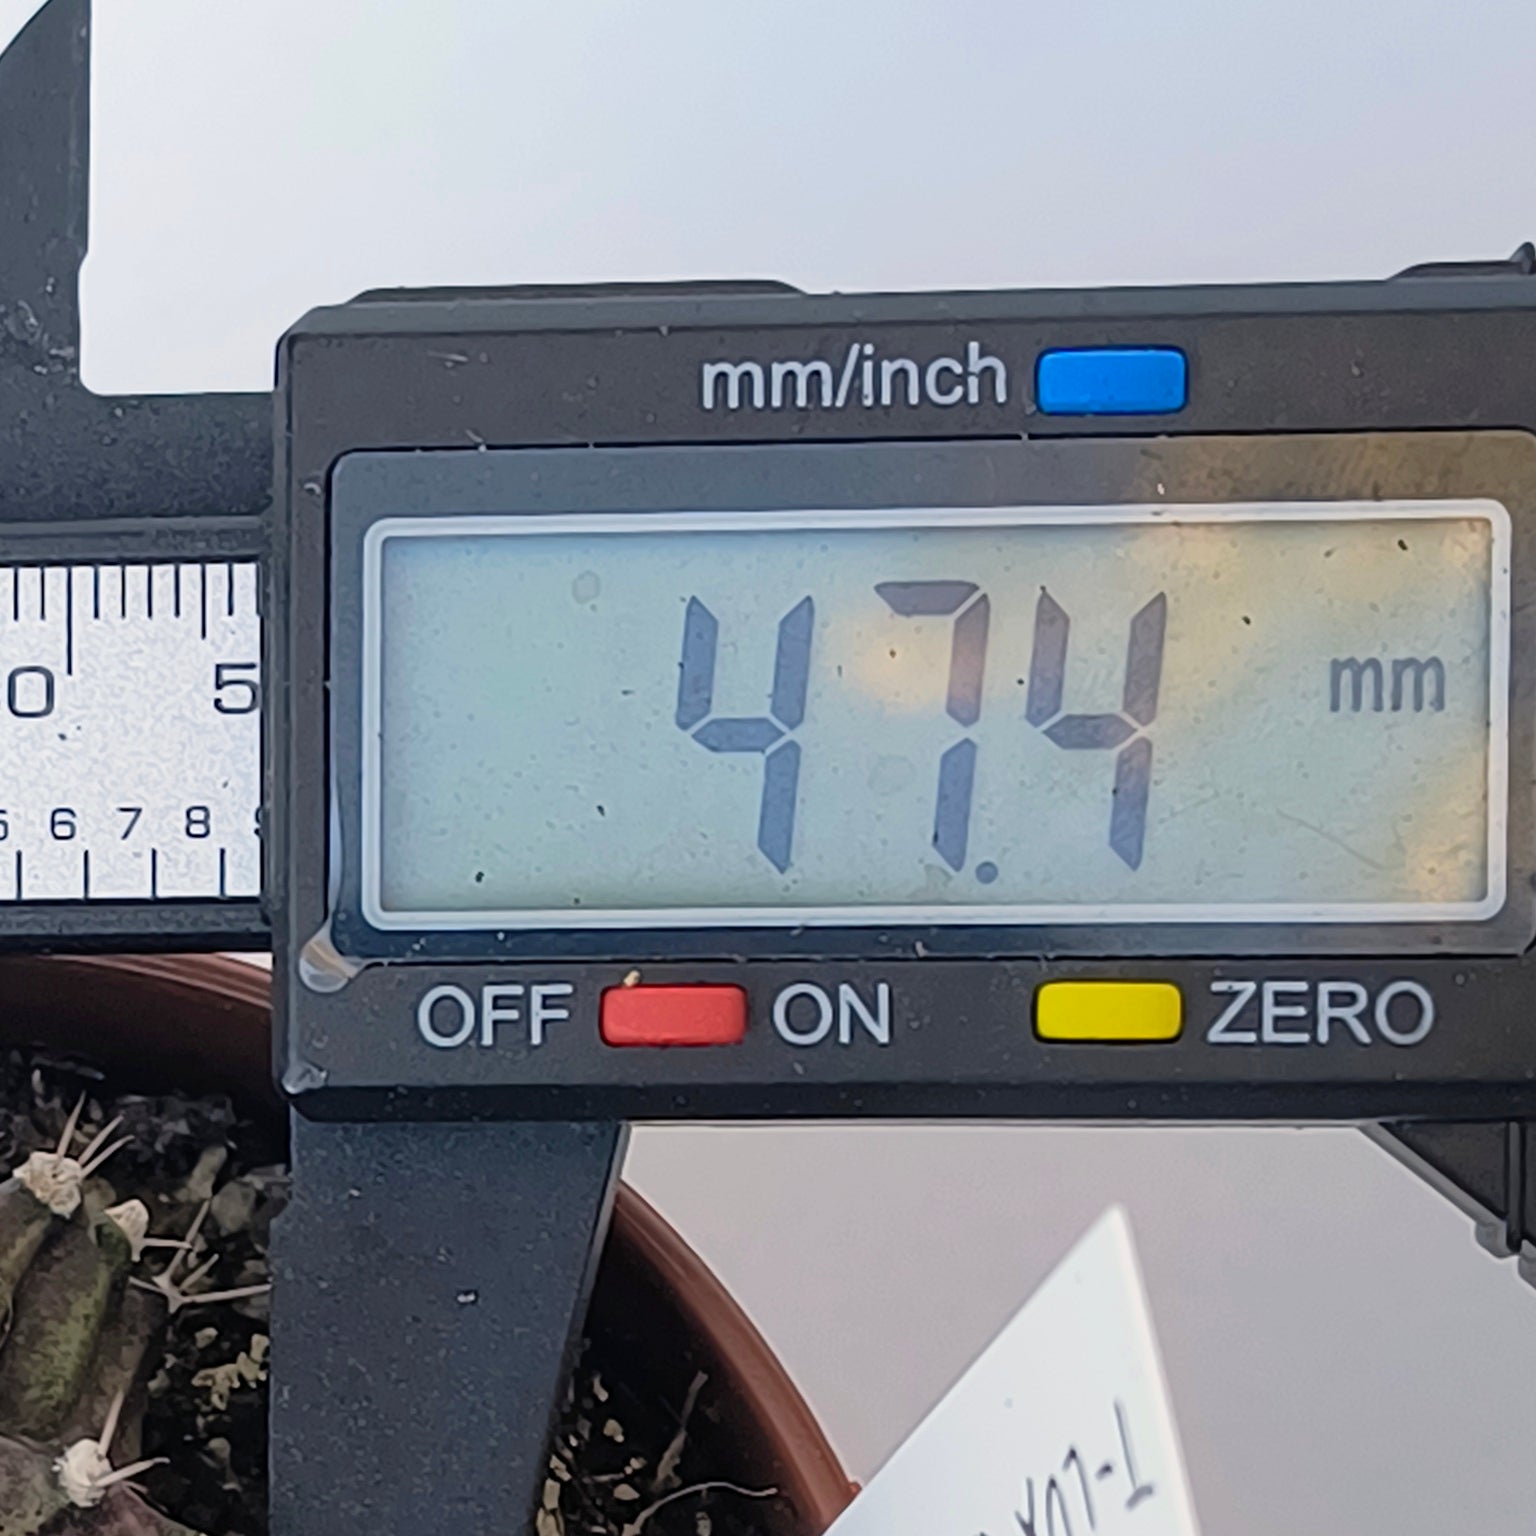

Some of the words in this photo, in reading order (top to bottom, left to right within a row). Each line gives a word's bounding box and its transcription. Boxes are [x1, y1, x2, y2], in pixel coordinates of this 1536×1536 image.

[701, 342, 1008, 411] mm/inch
[675, 579, 1168, 885] 47.4
[1328, 652, 1448, 714] mm
[50, 807, 77, 841] 6
[117, 807, 143, 841] 7
[184, 805, 211, 839] 8
[417, 984, 576, 1048] OFF
[771, 982, 893, 1046] ON
[1206, 980, 1436, 1047] ZERO
